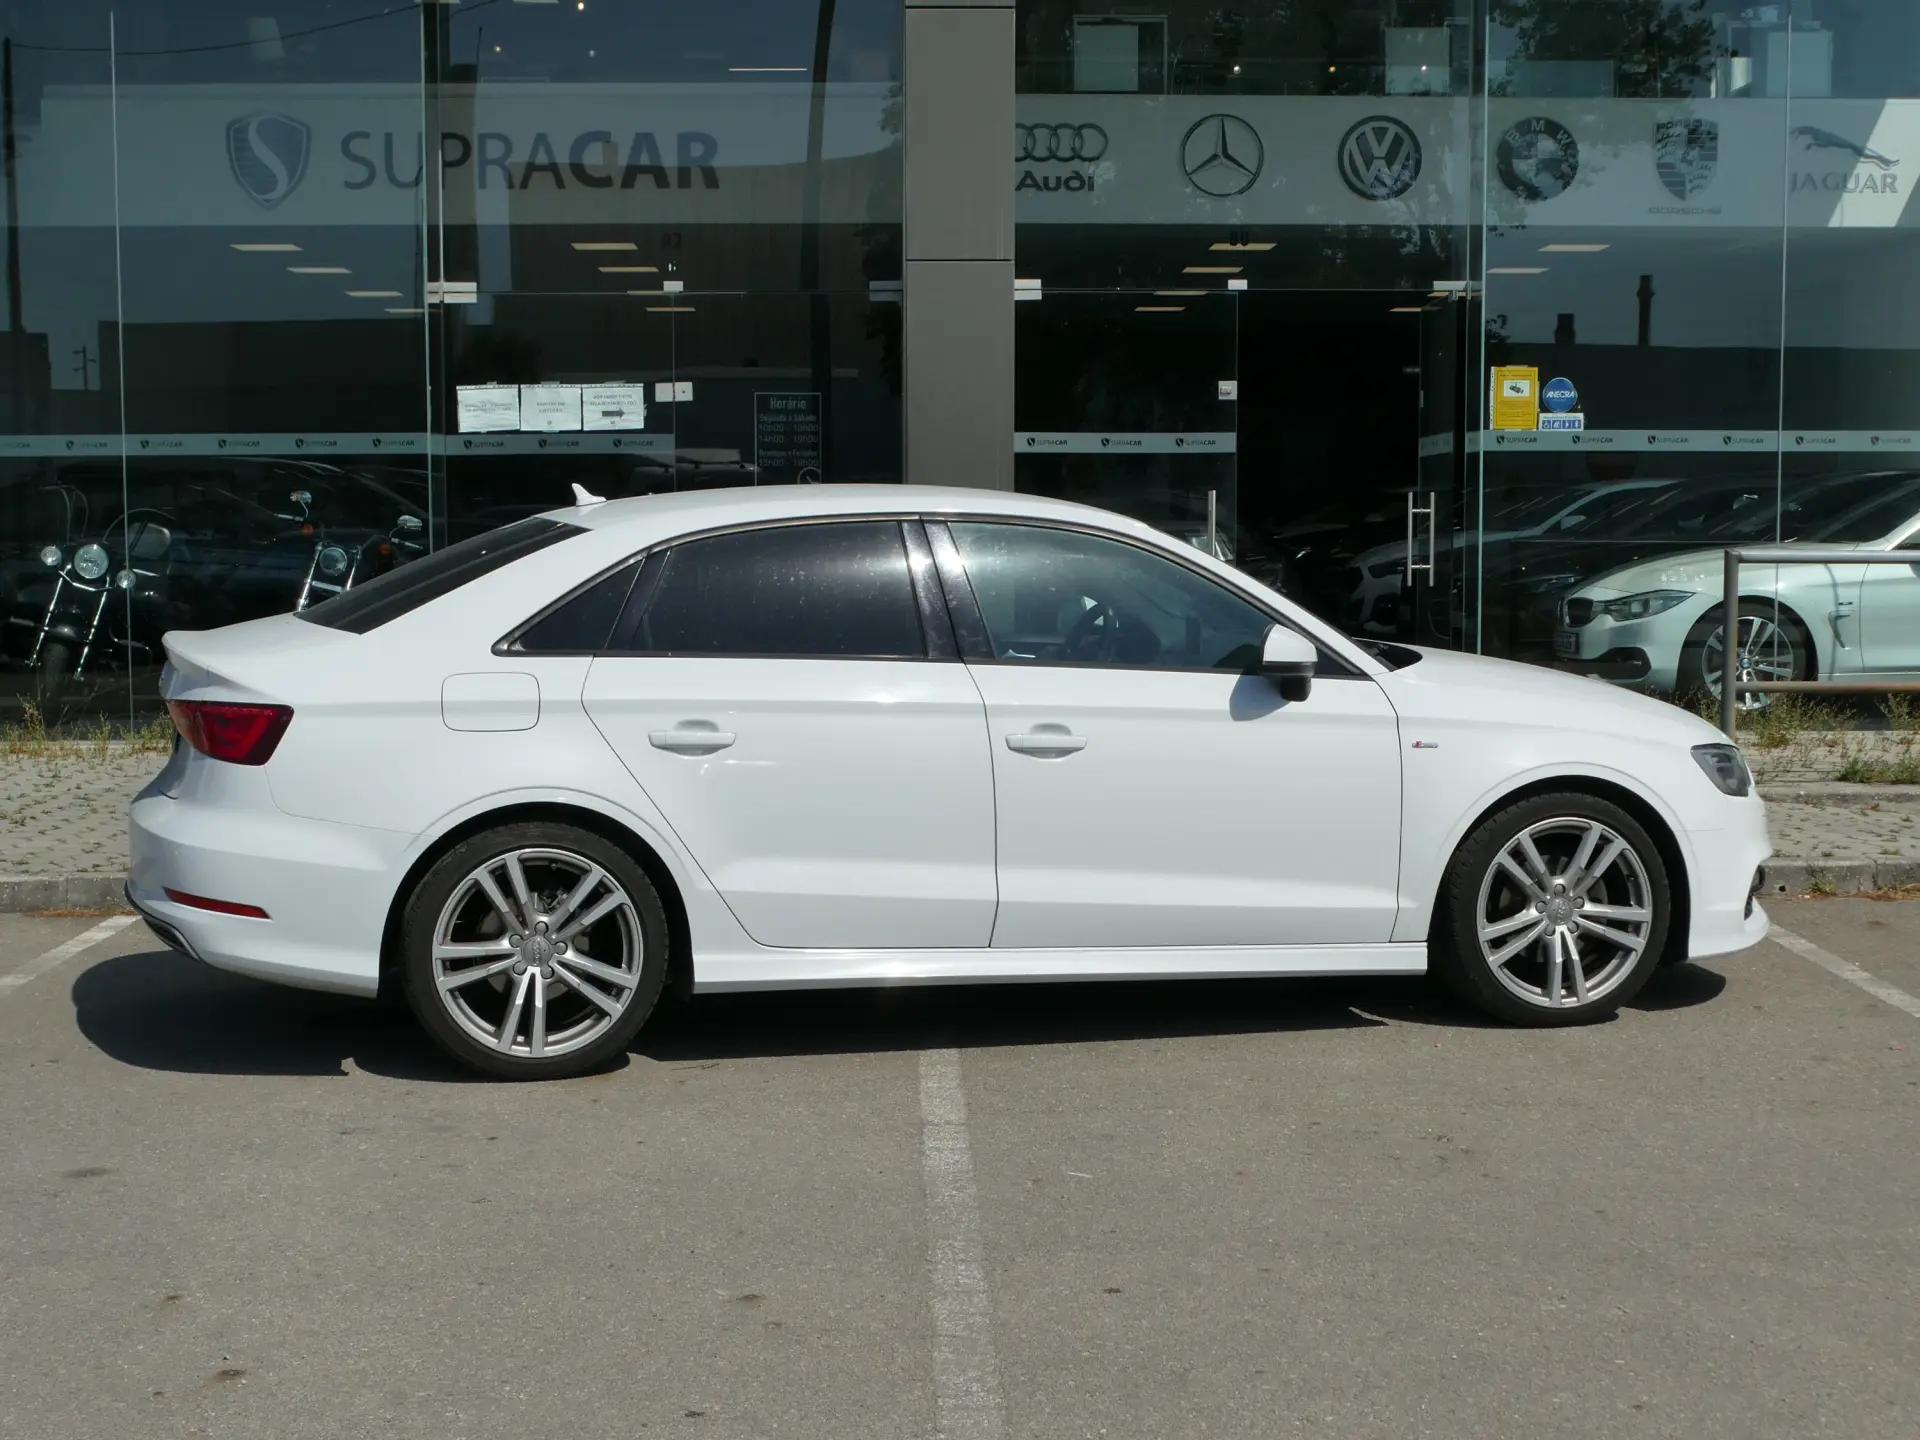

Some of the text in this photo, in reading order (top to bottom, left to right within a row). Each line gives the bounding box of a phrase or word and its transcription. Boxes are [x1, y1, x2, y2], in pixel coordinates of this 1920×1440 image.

[340, 129, 720, 190] SUPRACAR
[1016, 170, 1095, 192] Audi
[1791, 173, 1899, 194] JAGUAR
[1647, 206, 1722, 214] PORSCHE
[1546, 390, 1575, 398] ANECRA
[770, 396, 807, 409] Horário
[758, 435, 784, 443] 14h00
[793, 435, 818, 443] 19h00
